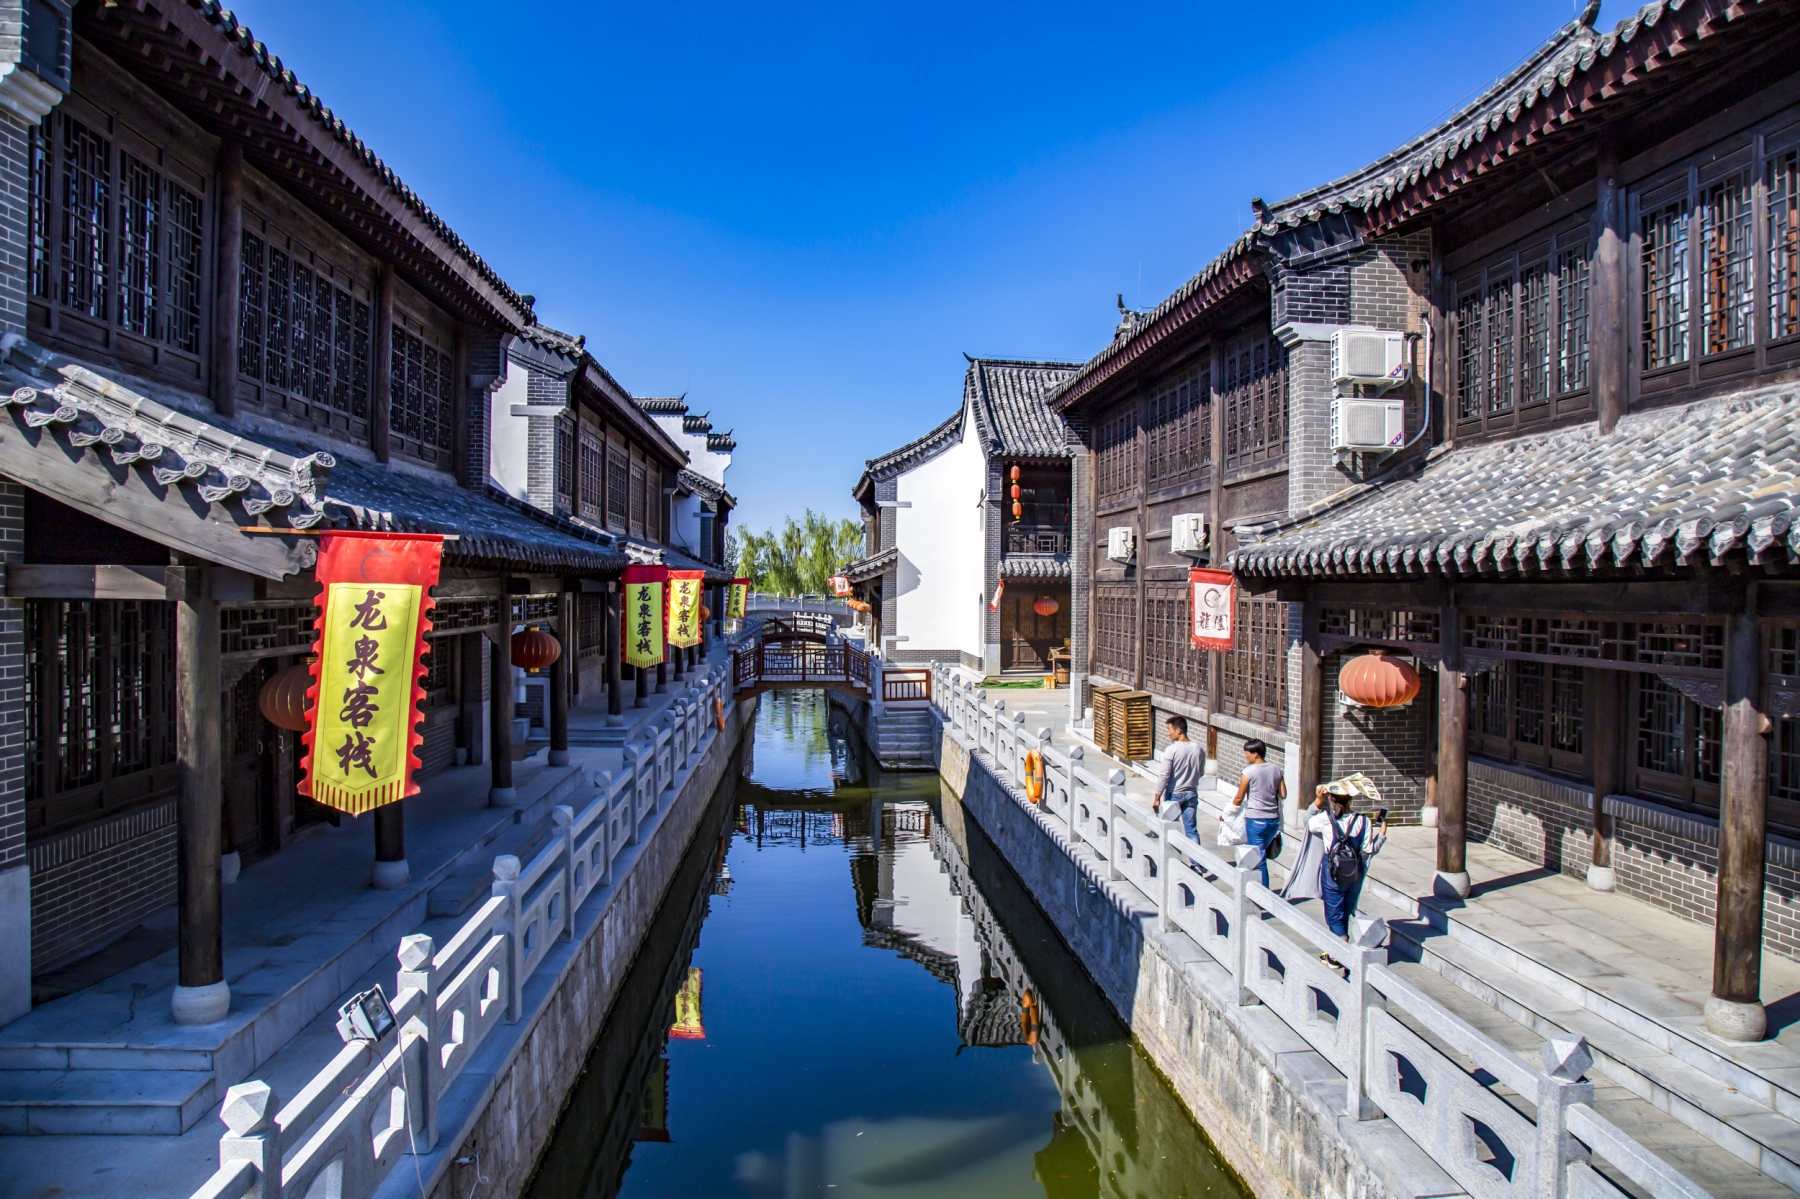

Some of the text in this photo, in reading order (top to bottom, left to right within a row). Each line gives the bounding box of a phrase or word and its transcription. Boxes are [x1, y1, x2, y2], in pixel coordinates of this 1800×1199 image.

[635, 586, 653, 656] 龙泉客栈
[677, 582, 691, 637] 龙泉客栈
[733, 585, 741, 613] 龙泉客栈
[335, 589, 388, 779] 龙泉客栈
